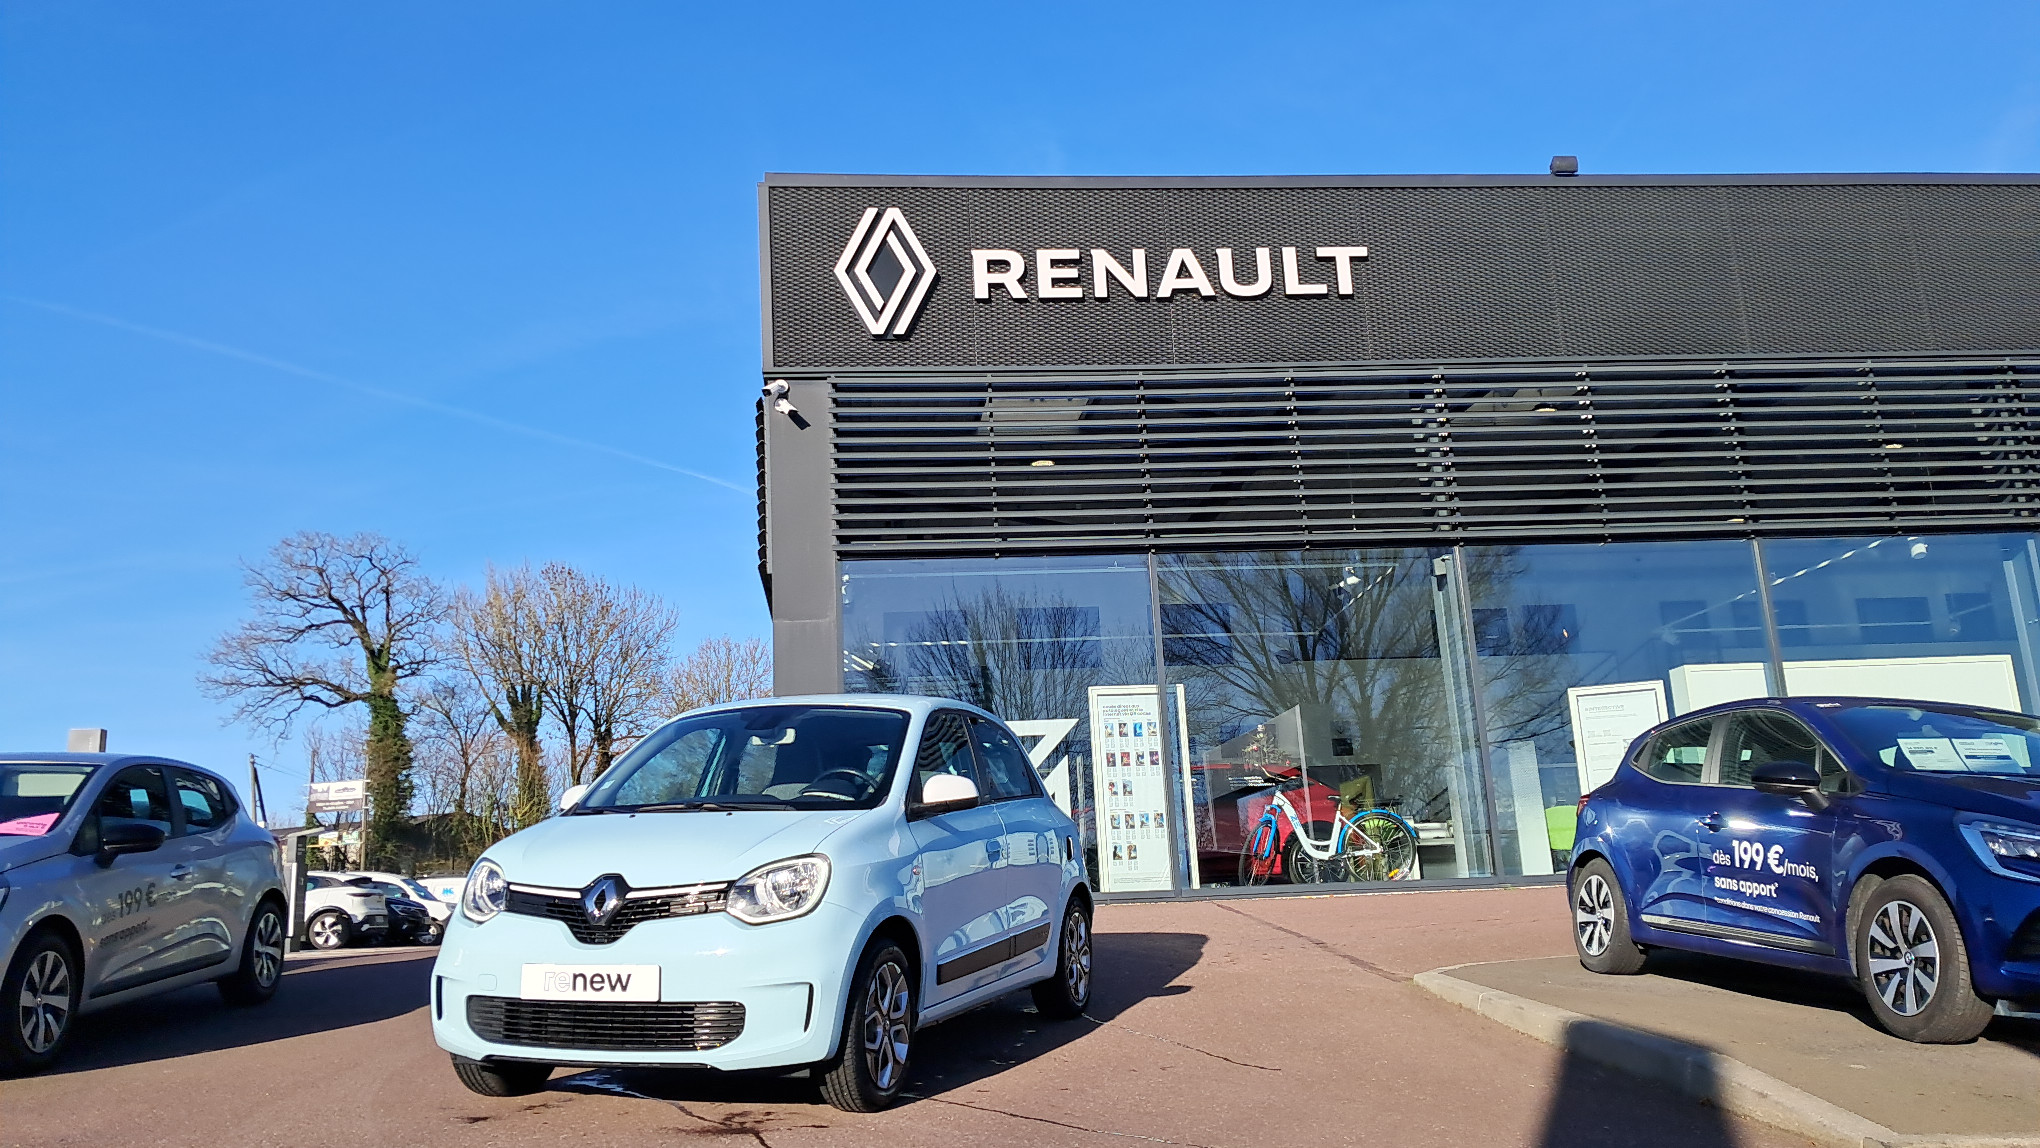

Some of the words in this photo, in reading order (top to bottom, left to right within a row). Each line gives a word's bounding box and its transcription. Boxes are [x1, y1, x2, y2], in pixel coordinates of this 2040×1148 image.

[970, 245, 1369, 300] RENAULT
[1712, 849, 1731, 866] dès
[1731, 839, 1765, 871] 199
[1714, 876, 1739, 892] sans
[118, 886, 143, 918] 199
[1768, 907, 1798, 919] concession
[543, 970, 633, 993] renew
